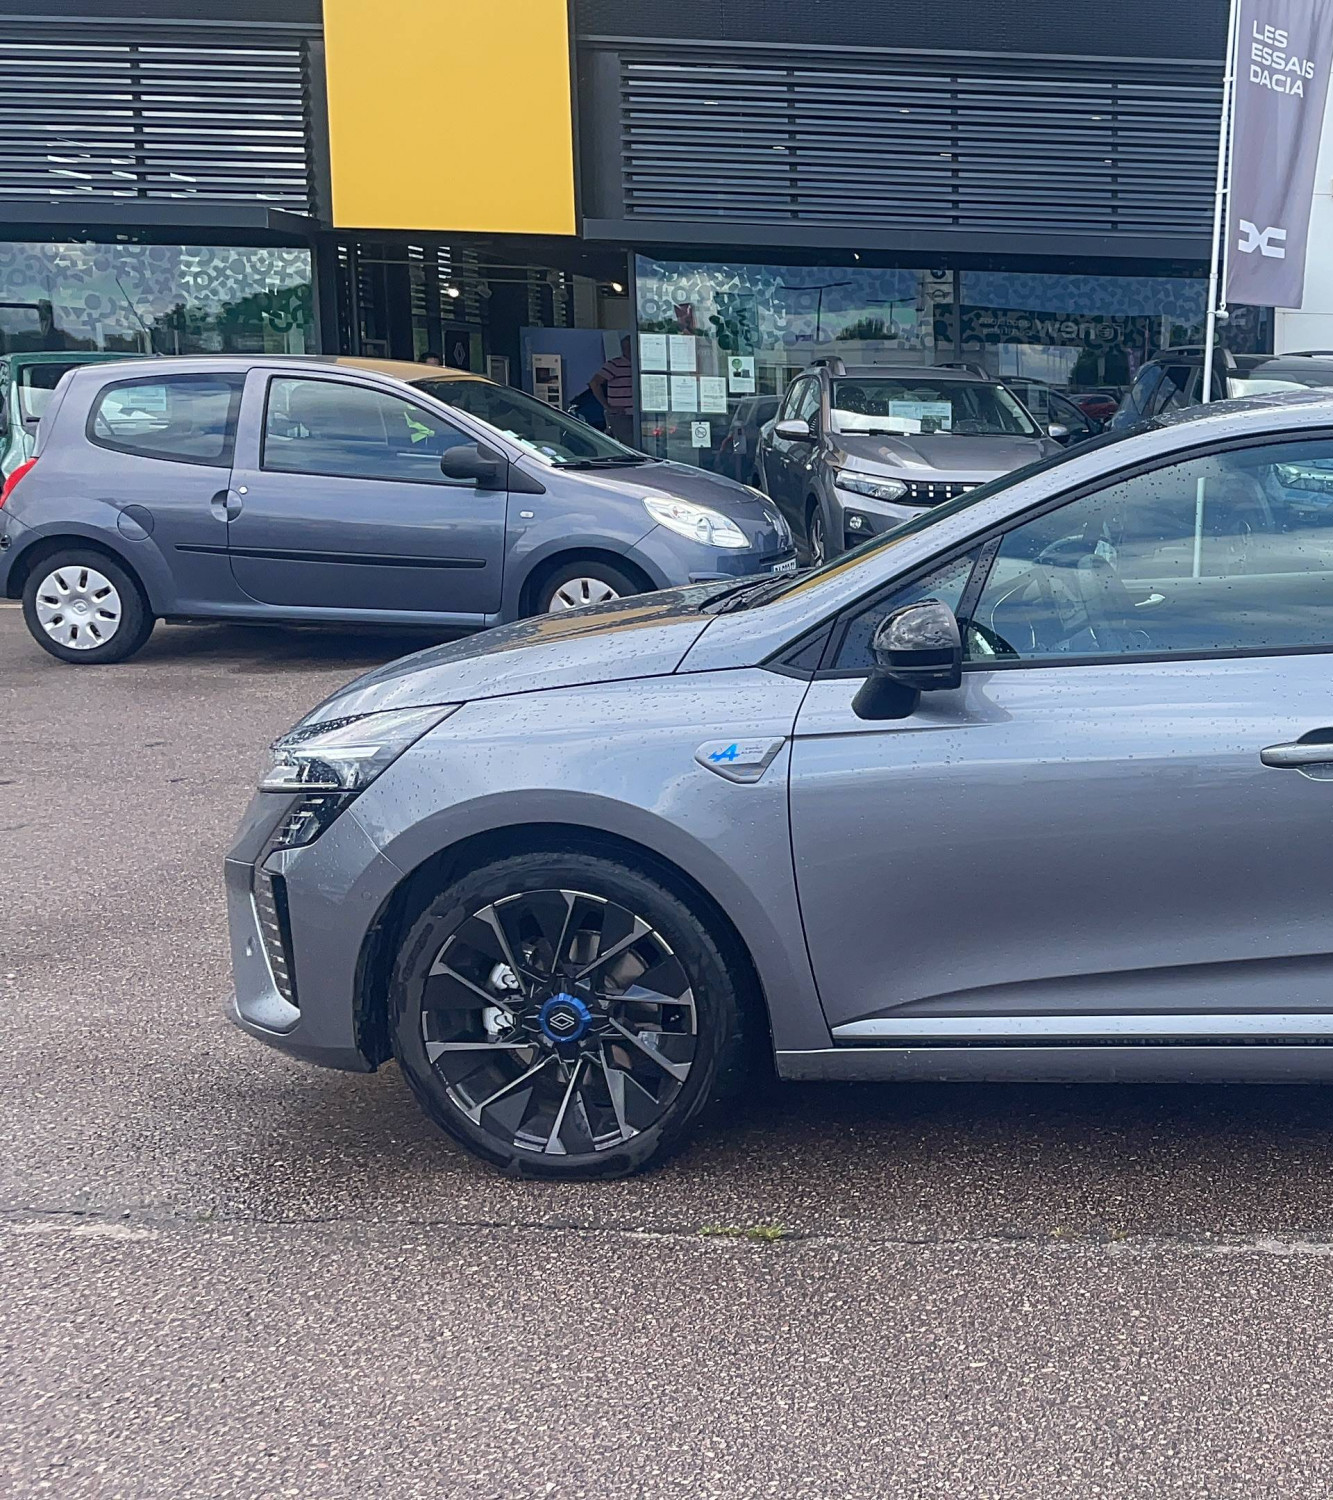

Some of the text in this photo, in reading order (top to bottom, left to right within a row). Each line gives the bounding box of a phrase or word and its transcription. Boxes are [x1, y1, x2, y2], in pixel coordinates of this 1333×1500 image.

[1252, 19, 1289, 48] LES
[1251, 42, 1315, 79] ESSAIS
[1249, 64, 1304, 98] DACIA
